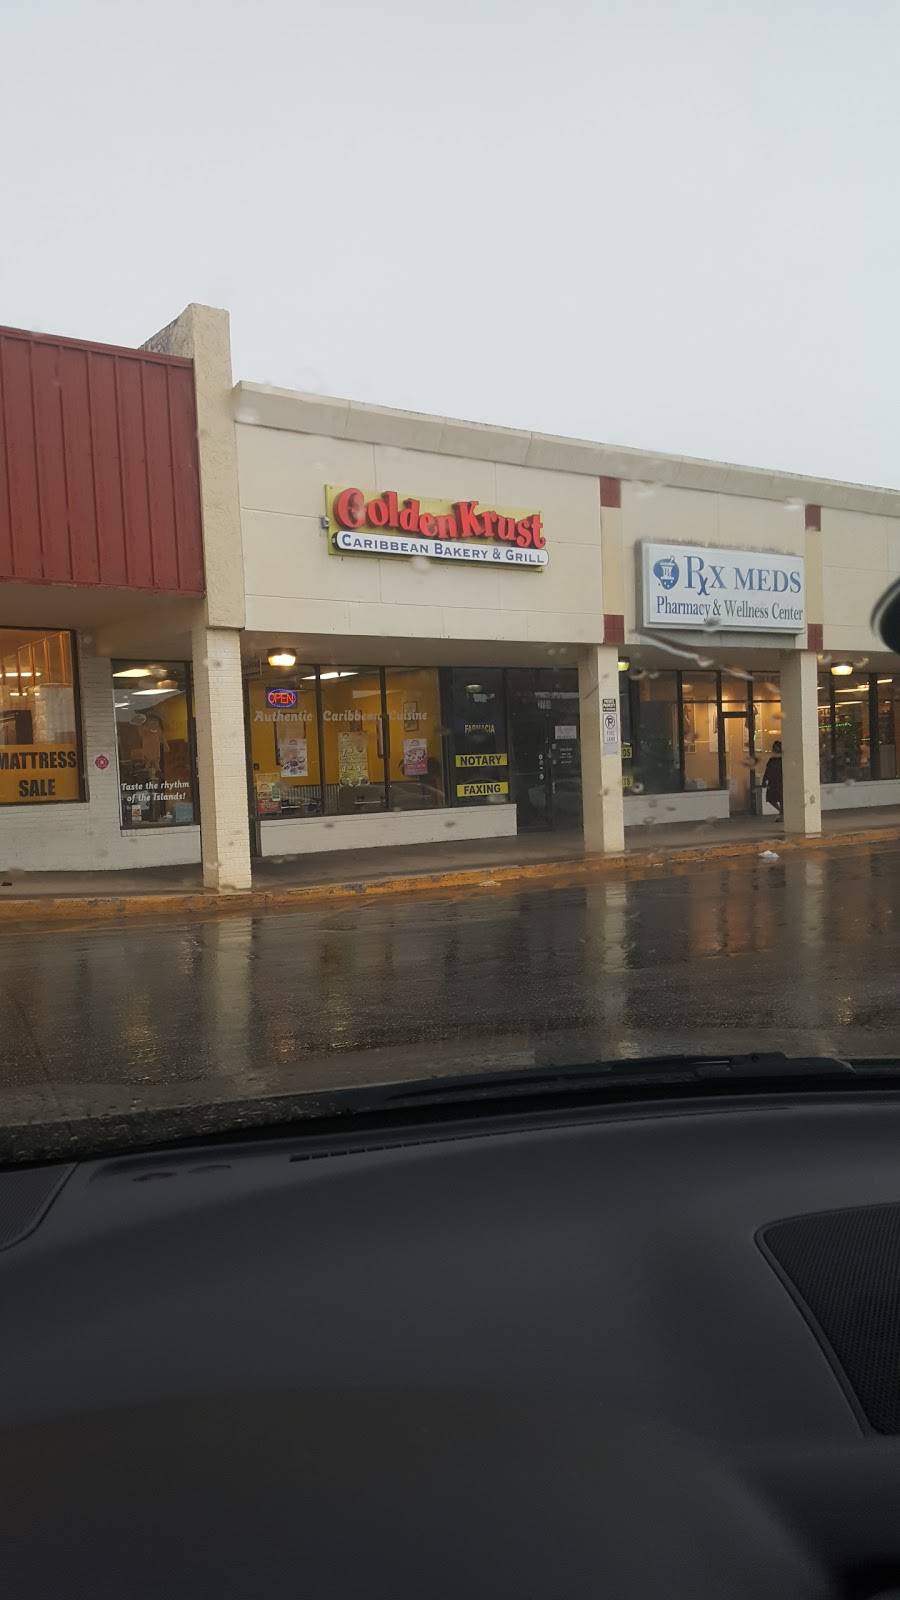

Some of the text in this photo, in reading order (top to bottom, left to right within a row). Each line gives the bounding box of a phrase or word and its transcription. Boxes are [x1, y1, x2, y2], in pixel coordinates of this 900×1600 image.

[341, 533, 545, 564] CARIBBEAN BAKERY & GRILL
[735, 567, 801, 594] MEDS
[656, 595, 804, 621] Pharmacy & Wellness Center
[269, 692, 295, 705] OPEN
[254, 710, 313, 723] Authentic
[0, 751, 77, 769] MATTRESS
[460, 754, 503, 767] NOTARY
[18, 779, 56, 797] SALE
[121, 780, 189, 791] Taste the rhythm
[463, 783, 501, 795] FAXING
[127, 792, 186, 804] of the Islands!
